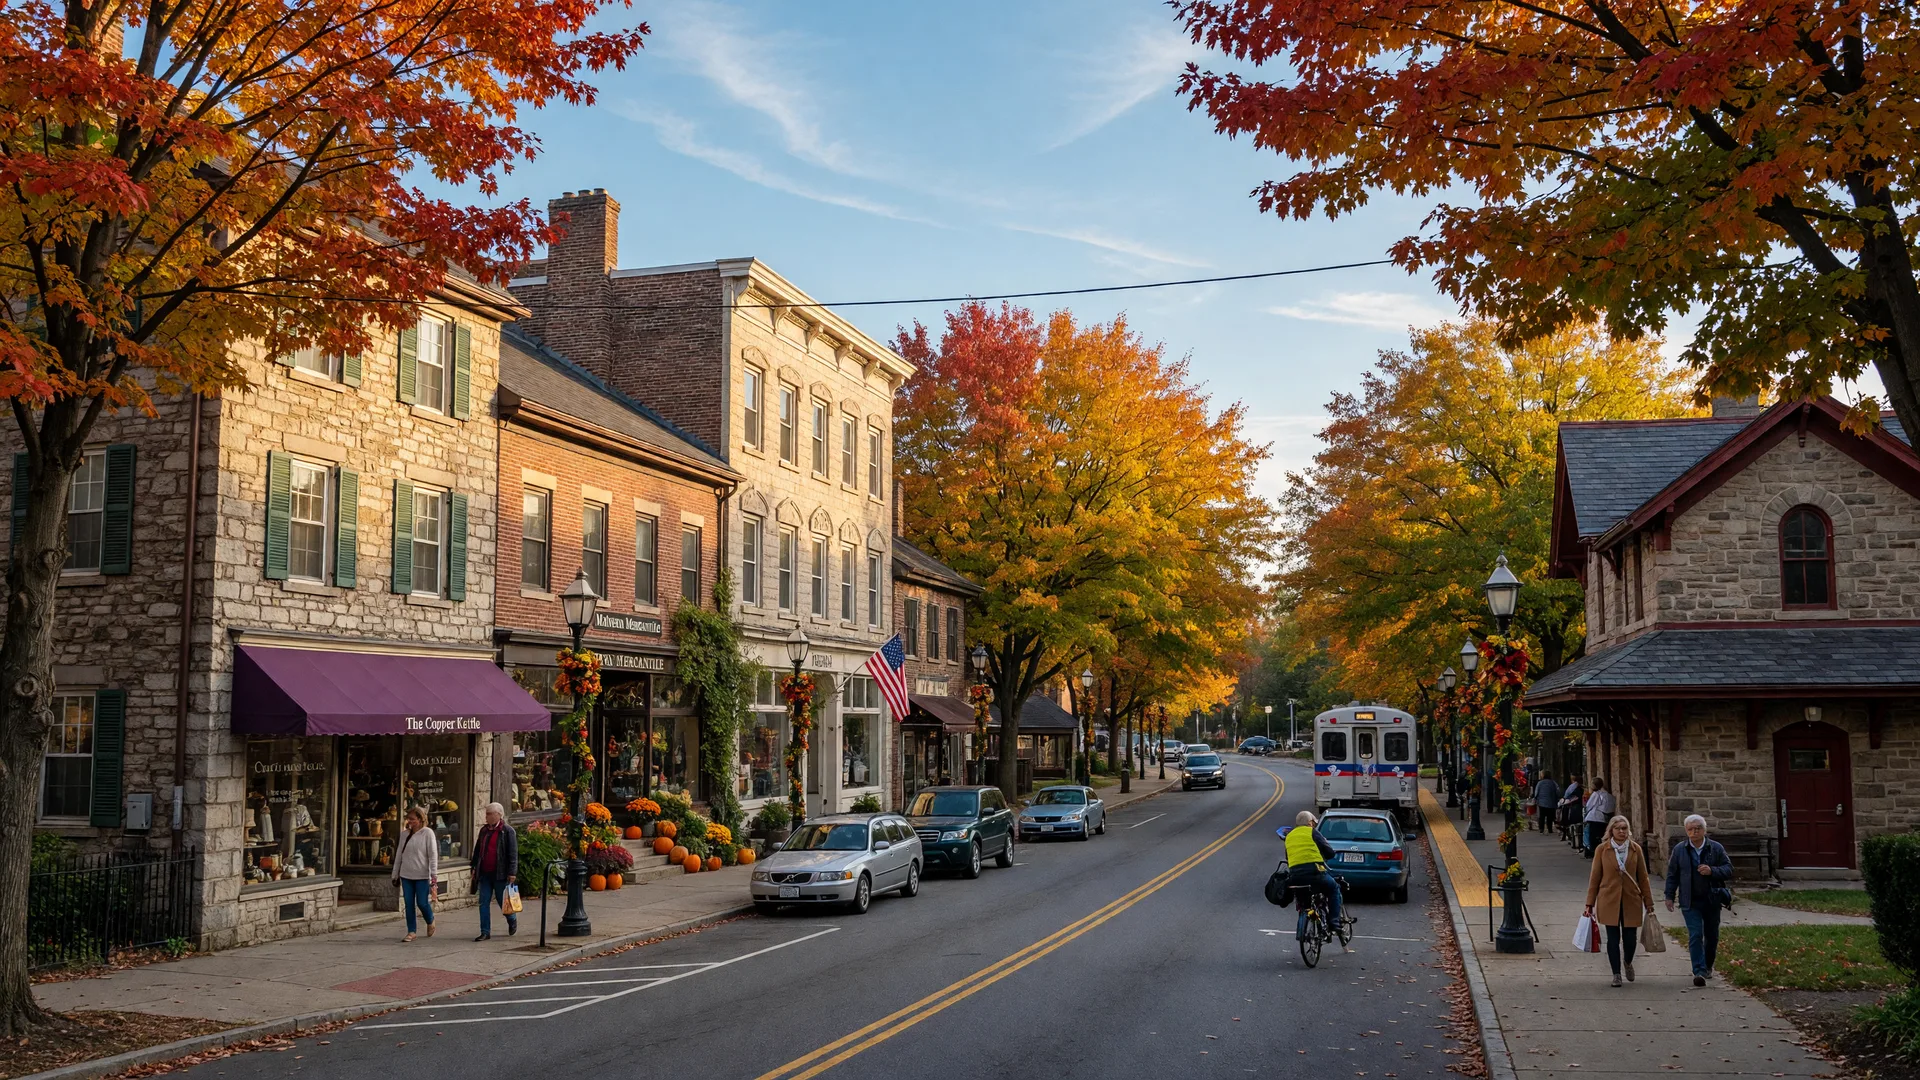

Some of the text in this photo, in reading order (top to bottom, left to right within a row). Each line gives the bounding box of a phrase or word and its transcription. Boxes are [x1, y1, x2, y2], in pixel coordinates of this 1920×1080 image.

[616, 655, 664, 670] MERCANTILE
[405, 716, 481, 733] The Copper Kettle
